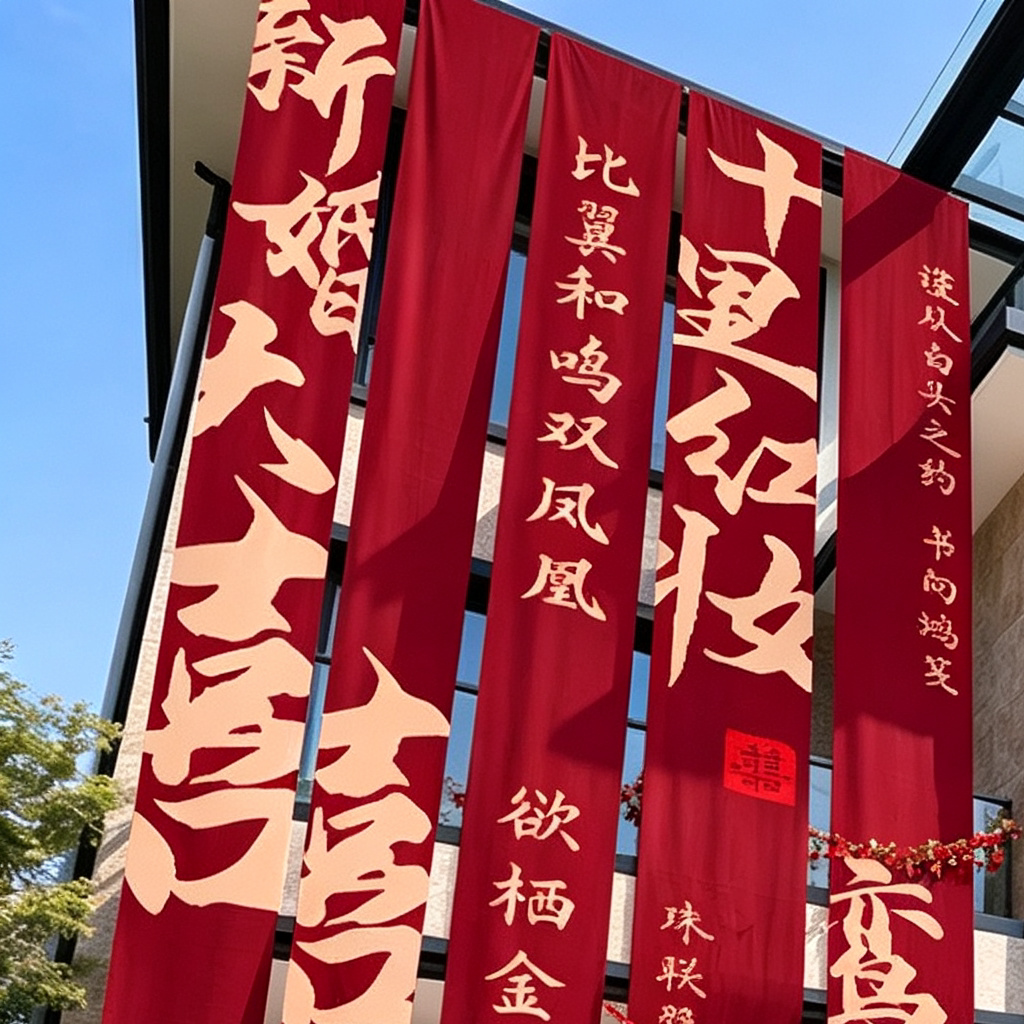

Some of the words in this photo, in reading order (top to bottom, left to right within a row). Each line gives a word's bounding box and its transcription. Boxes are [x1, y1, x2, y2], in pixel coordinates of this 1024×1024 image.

[521, 135, 641, 622] 比翼和鸣双凤凰
[654, 129, 822, 694] 十里红妆
